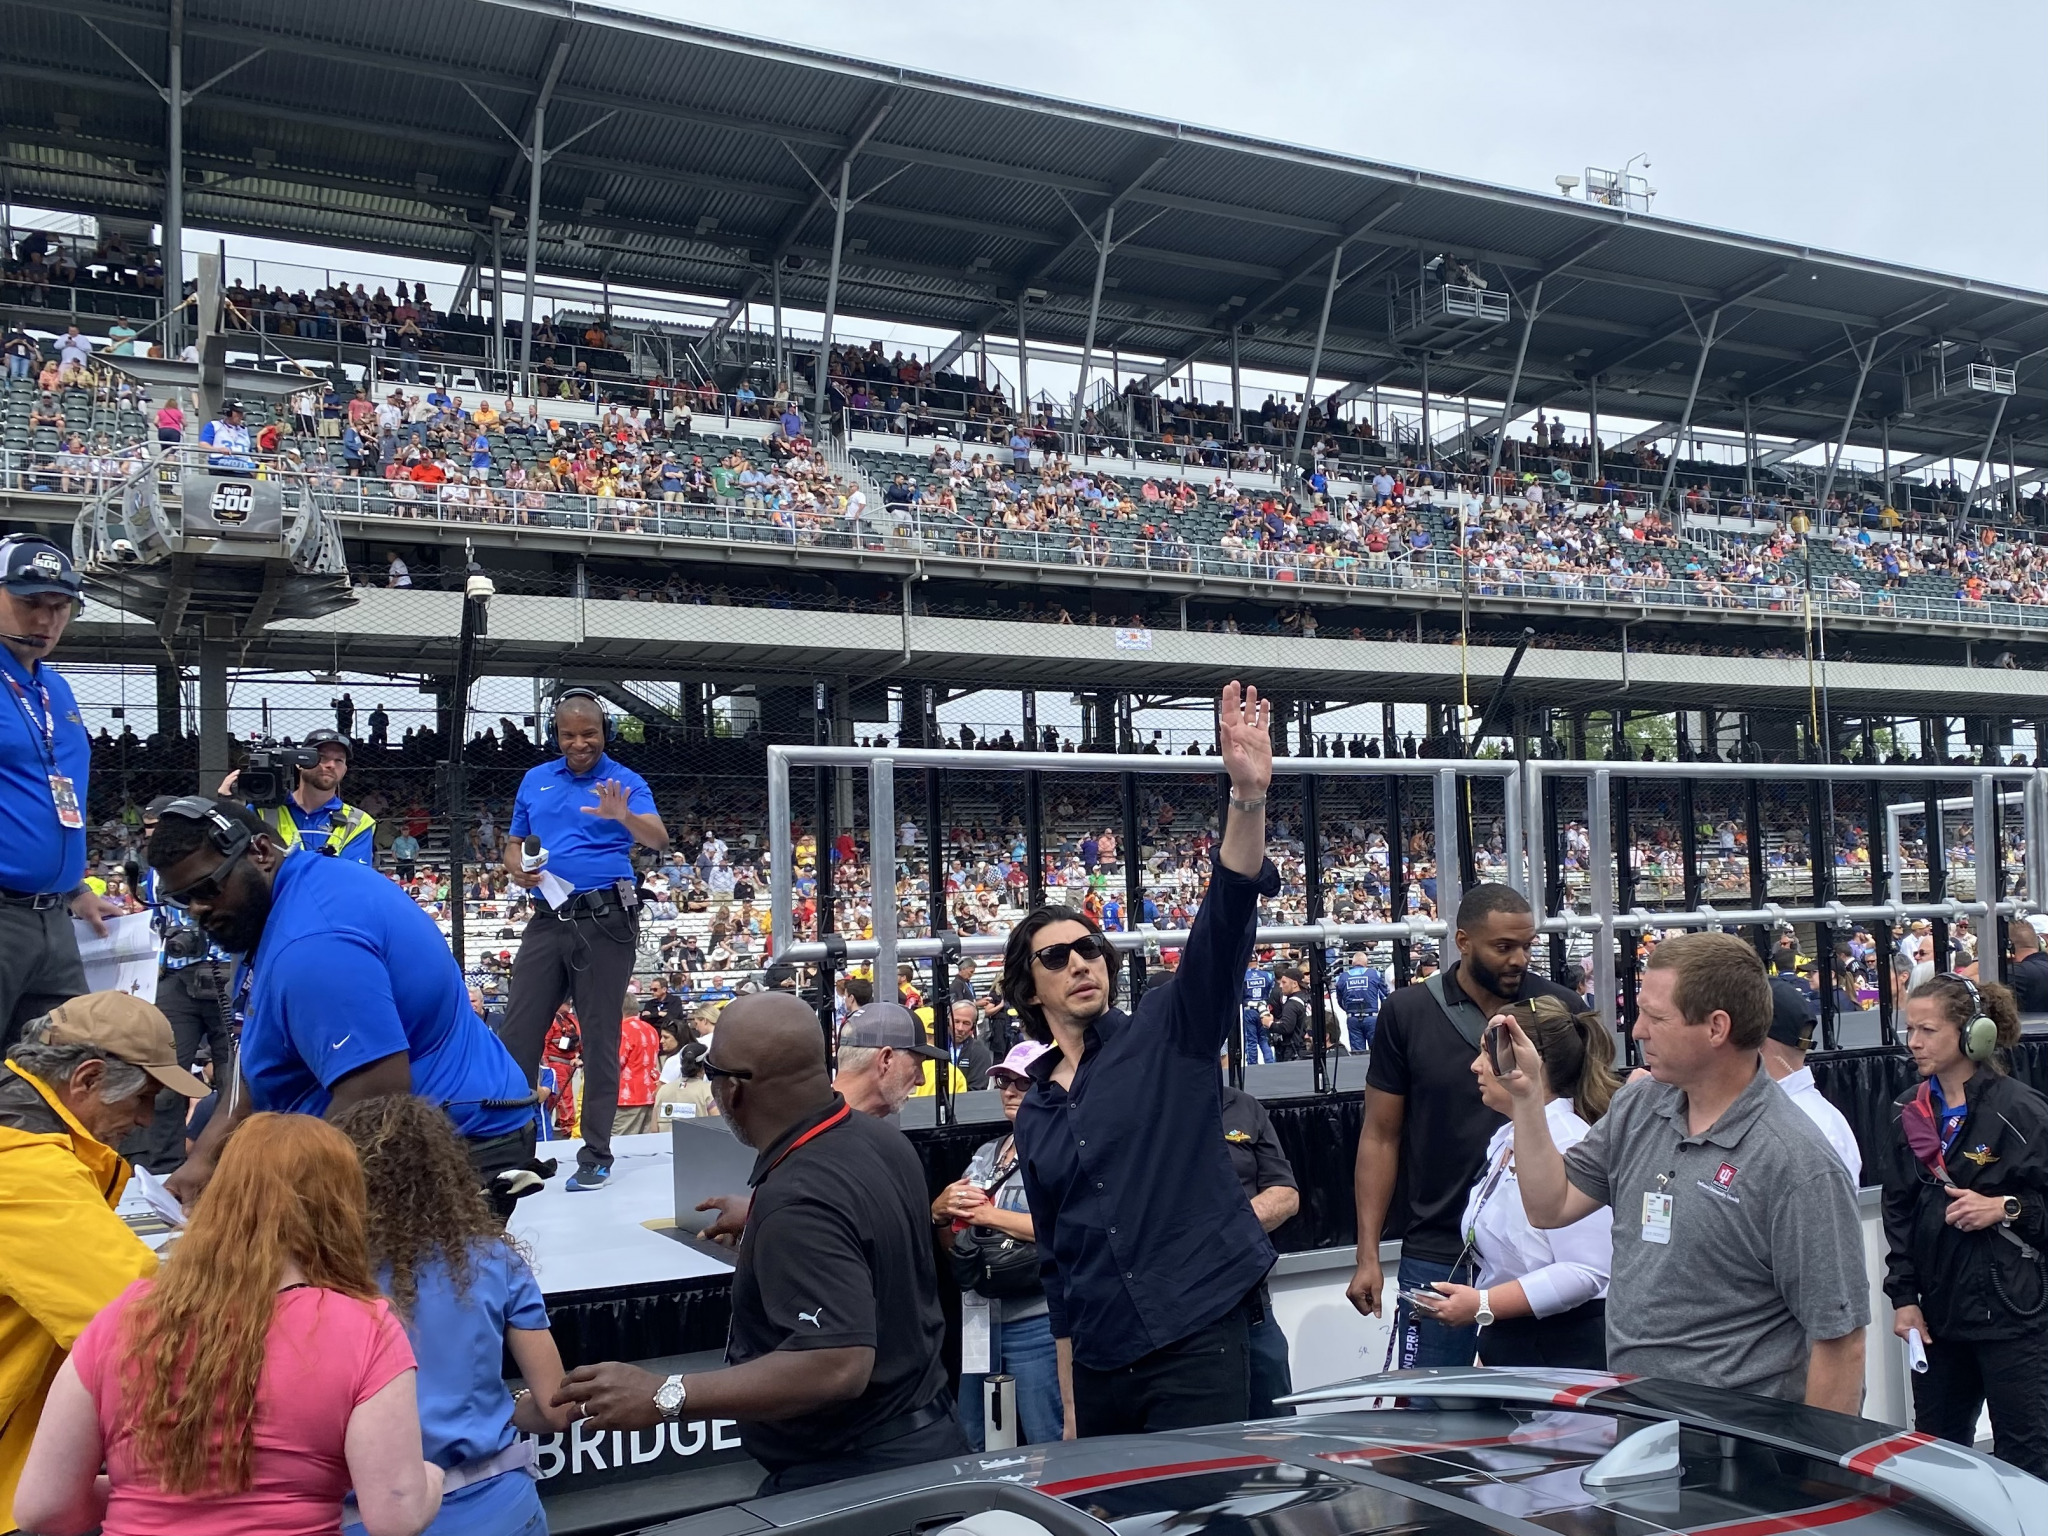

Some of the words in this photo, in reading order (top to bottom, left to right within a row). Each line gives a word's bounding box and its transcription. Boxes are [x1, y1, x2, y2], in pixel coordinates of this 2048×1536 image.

[223, 487, 247, 495] INDY
[211, 494, 254, 512] 500
[35, 559, 60, 571] 500
[1406, 1325, 1417, 1351] PRIX
[514, 1416, 742, 1480] BRIDGE
